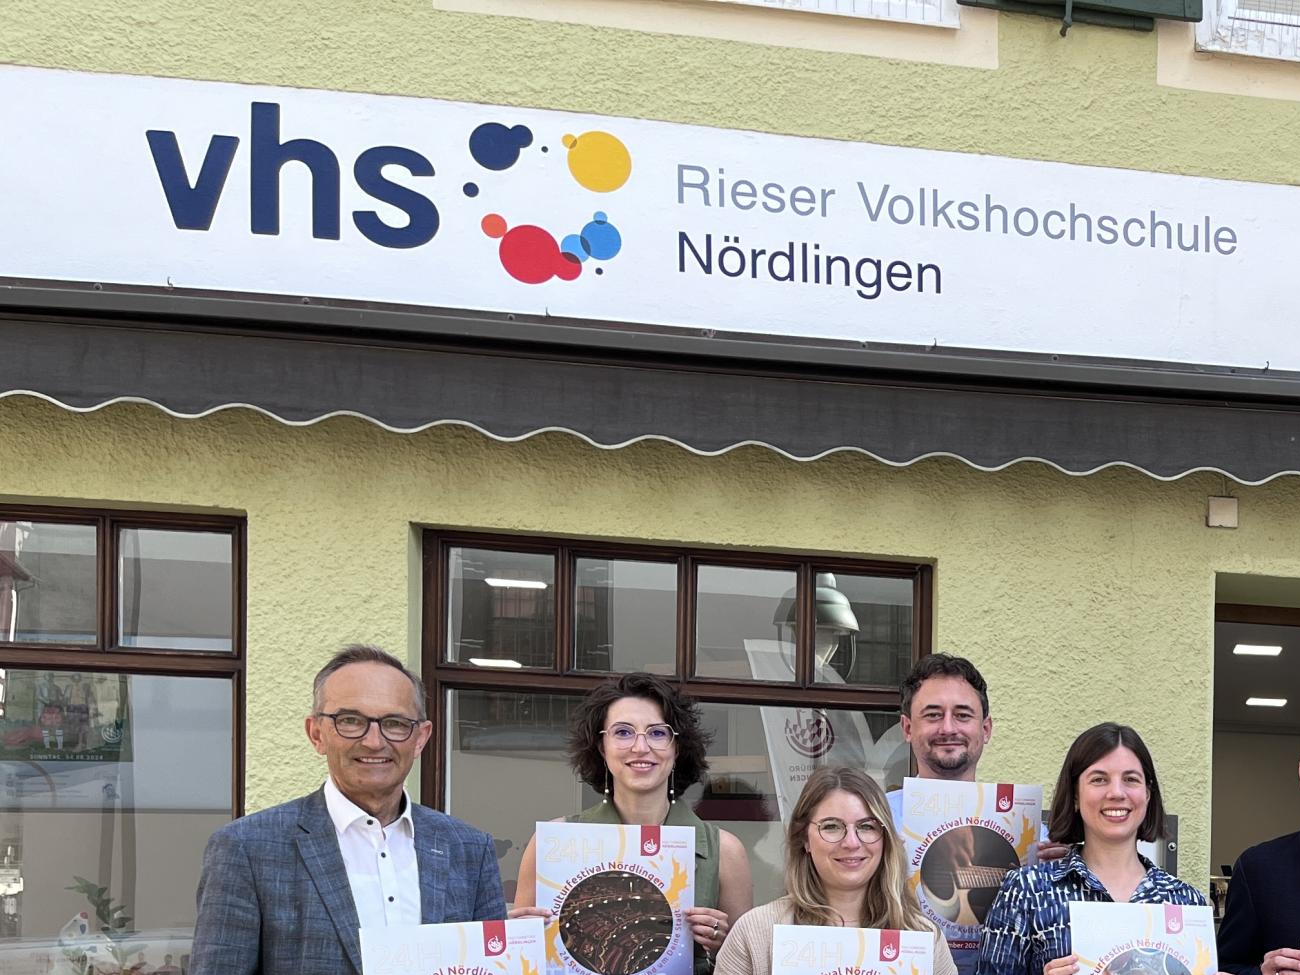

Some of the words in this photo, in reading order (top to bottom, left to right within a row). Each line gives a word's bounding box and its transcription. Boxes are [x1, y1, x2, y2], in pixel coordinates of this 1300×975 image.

[146, 102, 440, 249] vhs
[676, 163, 836, 219] Rieser
[857, 182, 1239, 256] Volkshochschule
[677, 232, 943, 299] Nördlingen
[912, 818, 963, 867] Kulturfestival
[966, 817, 1015, 843] Nördlingen
[551, 864, 605, 916] Kulturfestival
[609, 862, 665, 890] Nördlingen
[1137, 939, 1190, 966] Nördlingen
